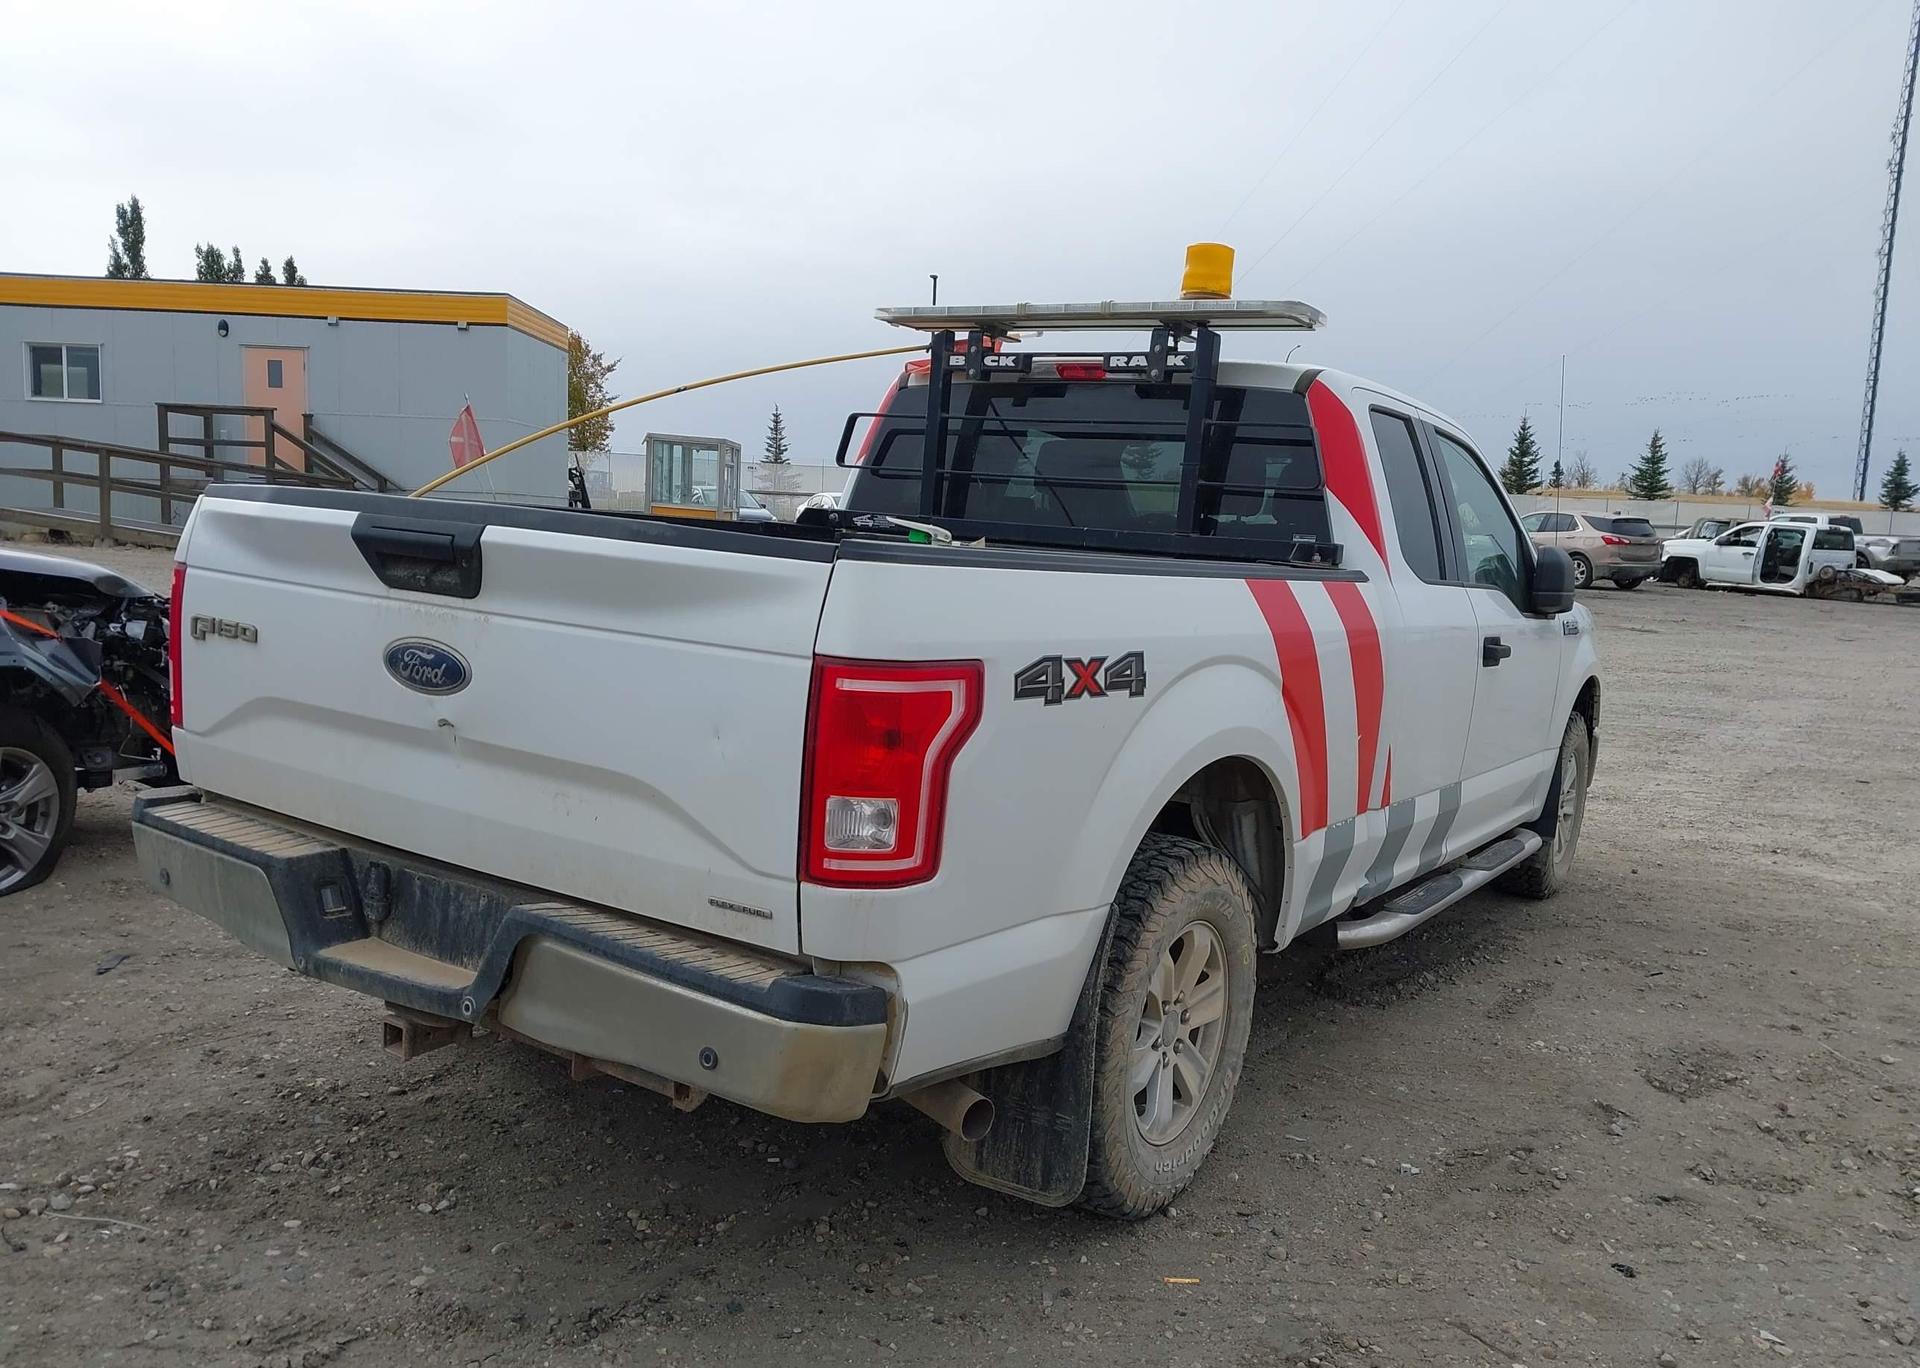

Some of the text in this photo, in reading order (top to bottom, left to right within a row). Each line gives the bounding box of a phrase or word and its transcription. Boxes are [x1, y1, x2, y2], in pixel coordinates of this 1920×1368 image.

[949, 354, 1187, 367] BCK RAK
[400, 649, 446, 684] Ford
